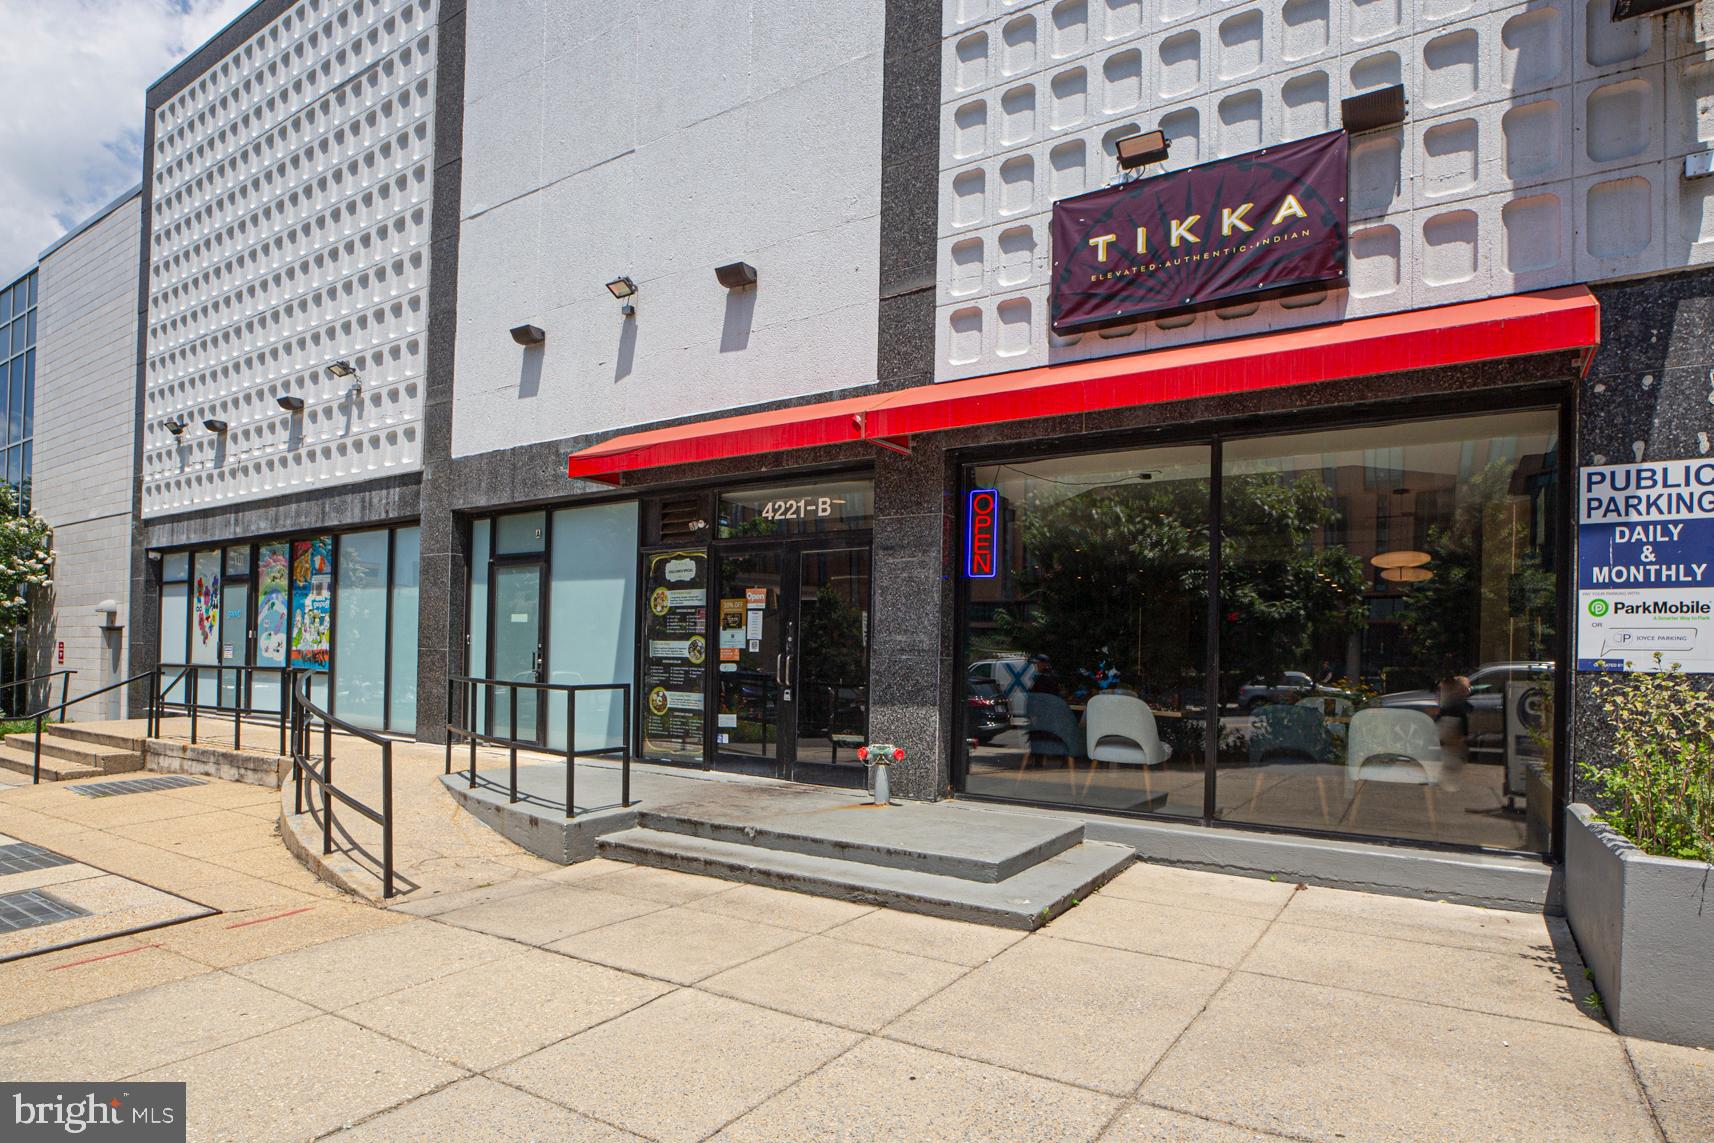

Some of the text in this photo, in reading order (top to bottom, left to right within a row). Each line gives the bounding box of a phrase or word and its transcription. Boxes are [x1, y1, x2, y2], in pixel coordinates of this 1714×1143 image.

[1089, 194, 1308, 263] TIKKA
[1586, 463, 1714, 493] PUBLIC
[762, 497, 831, 520] 4221-B
[1586, 490, 1714, 519] PARKING
[973, 493, 994, 574] OPEN
[1615, 523, 1684, 544] DAILY
[1640, 545, 1656, 562] &
[1592, 563, 1707, 584] MONTHLY
[746, 592, 765, 602] Open
[1614, 600, 1711, 615] ParkMobile
